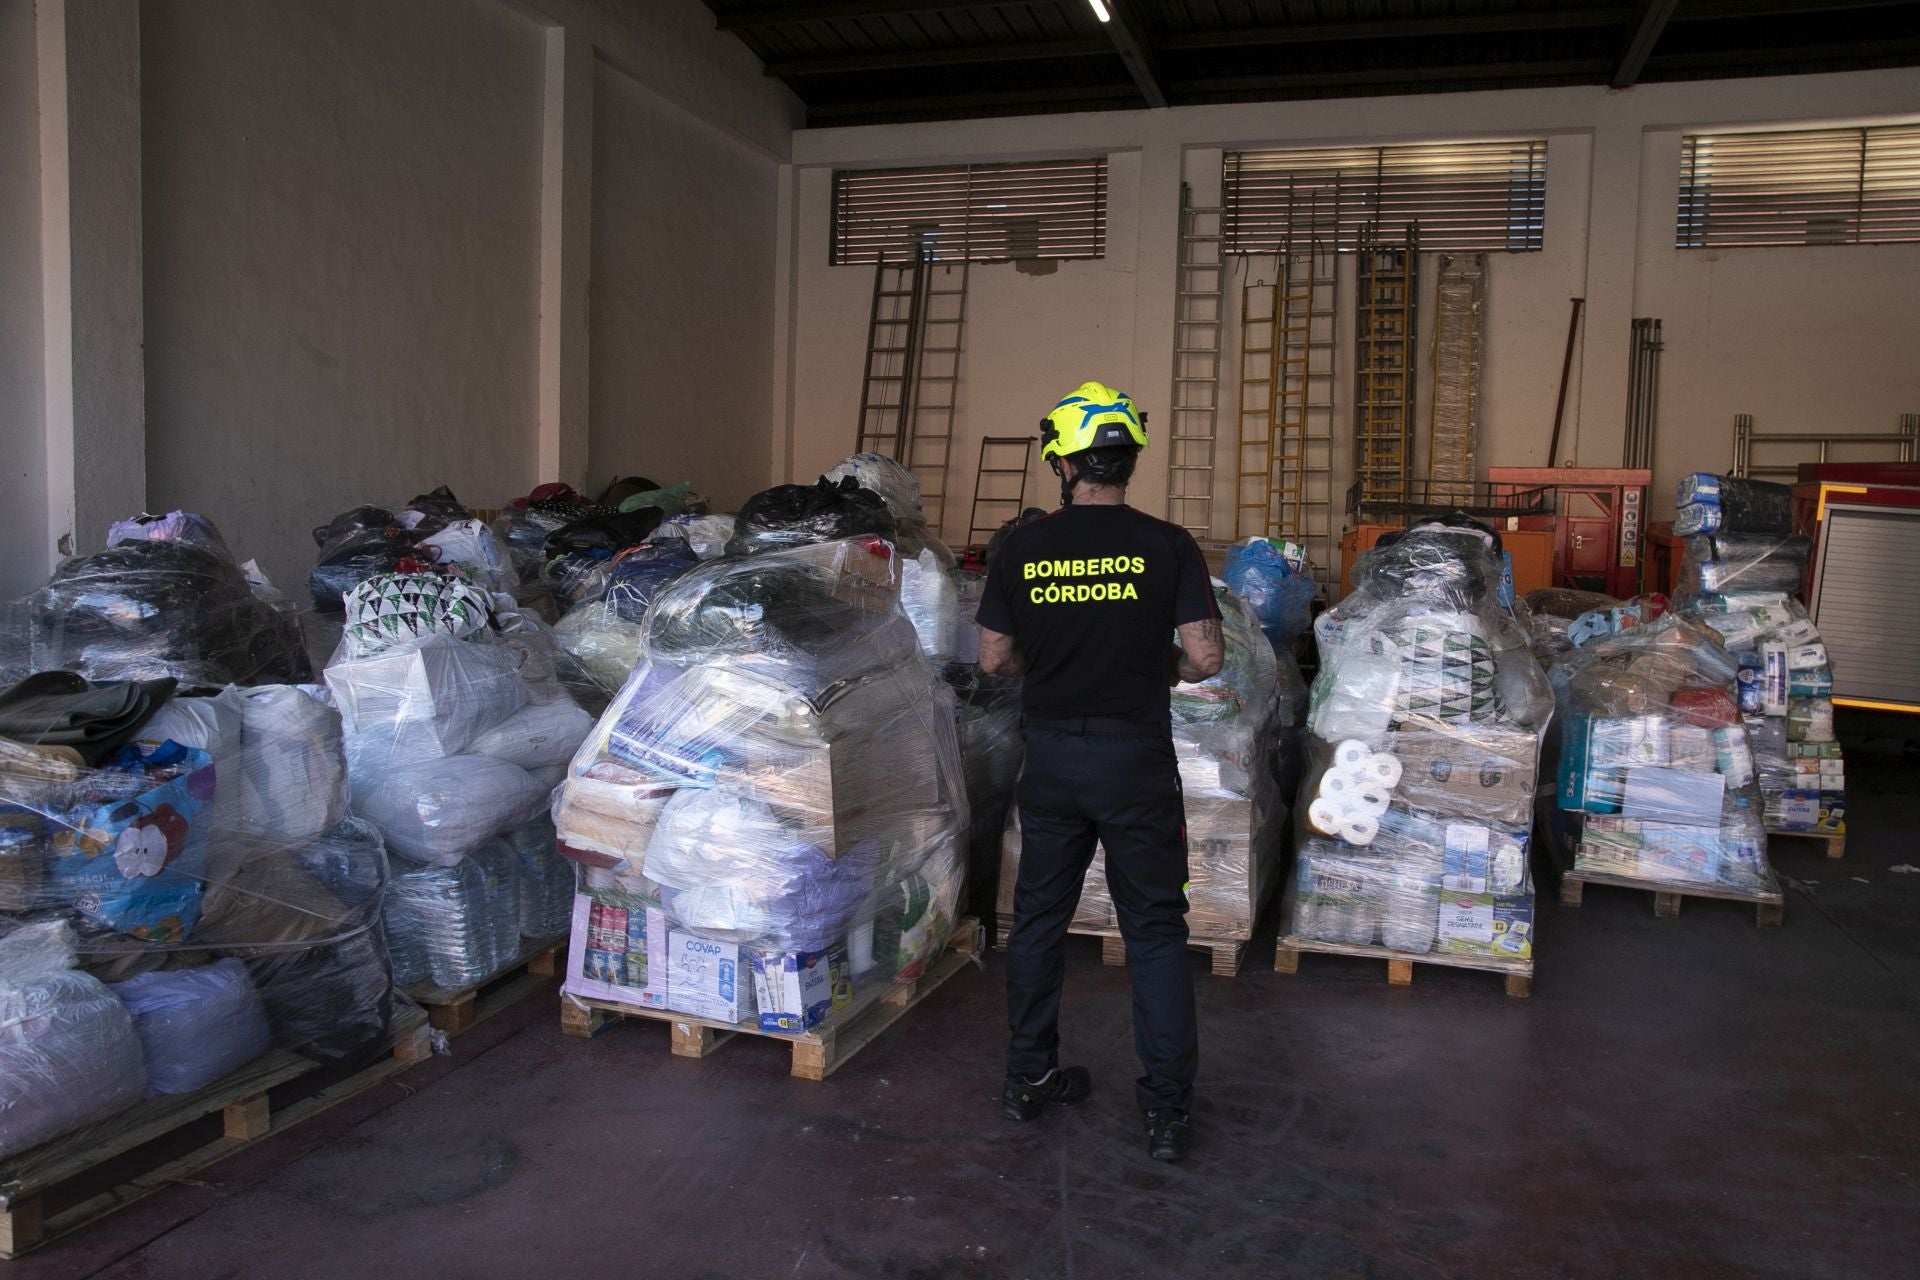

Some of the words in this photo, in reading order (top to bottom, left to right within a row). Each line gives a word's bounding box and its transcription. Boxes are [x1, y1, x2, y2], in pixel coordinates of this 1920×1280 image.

[1023, 556, 1145, 580] BOMBEROS
[1030, 583, 1138, 604] CÓRDOBA
[686, 940, 721, 955] COVAP
[805, 975, 824, 990] ENTERA
